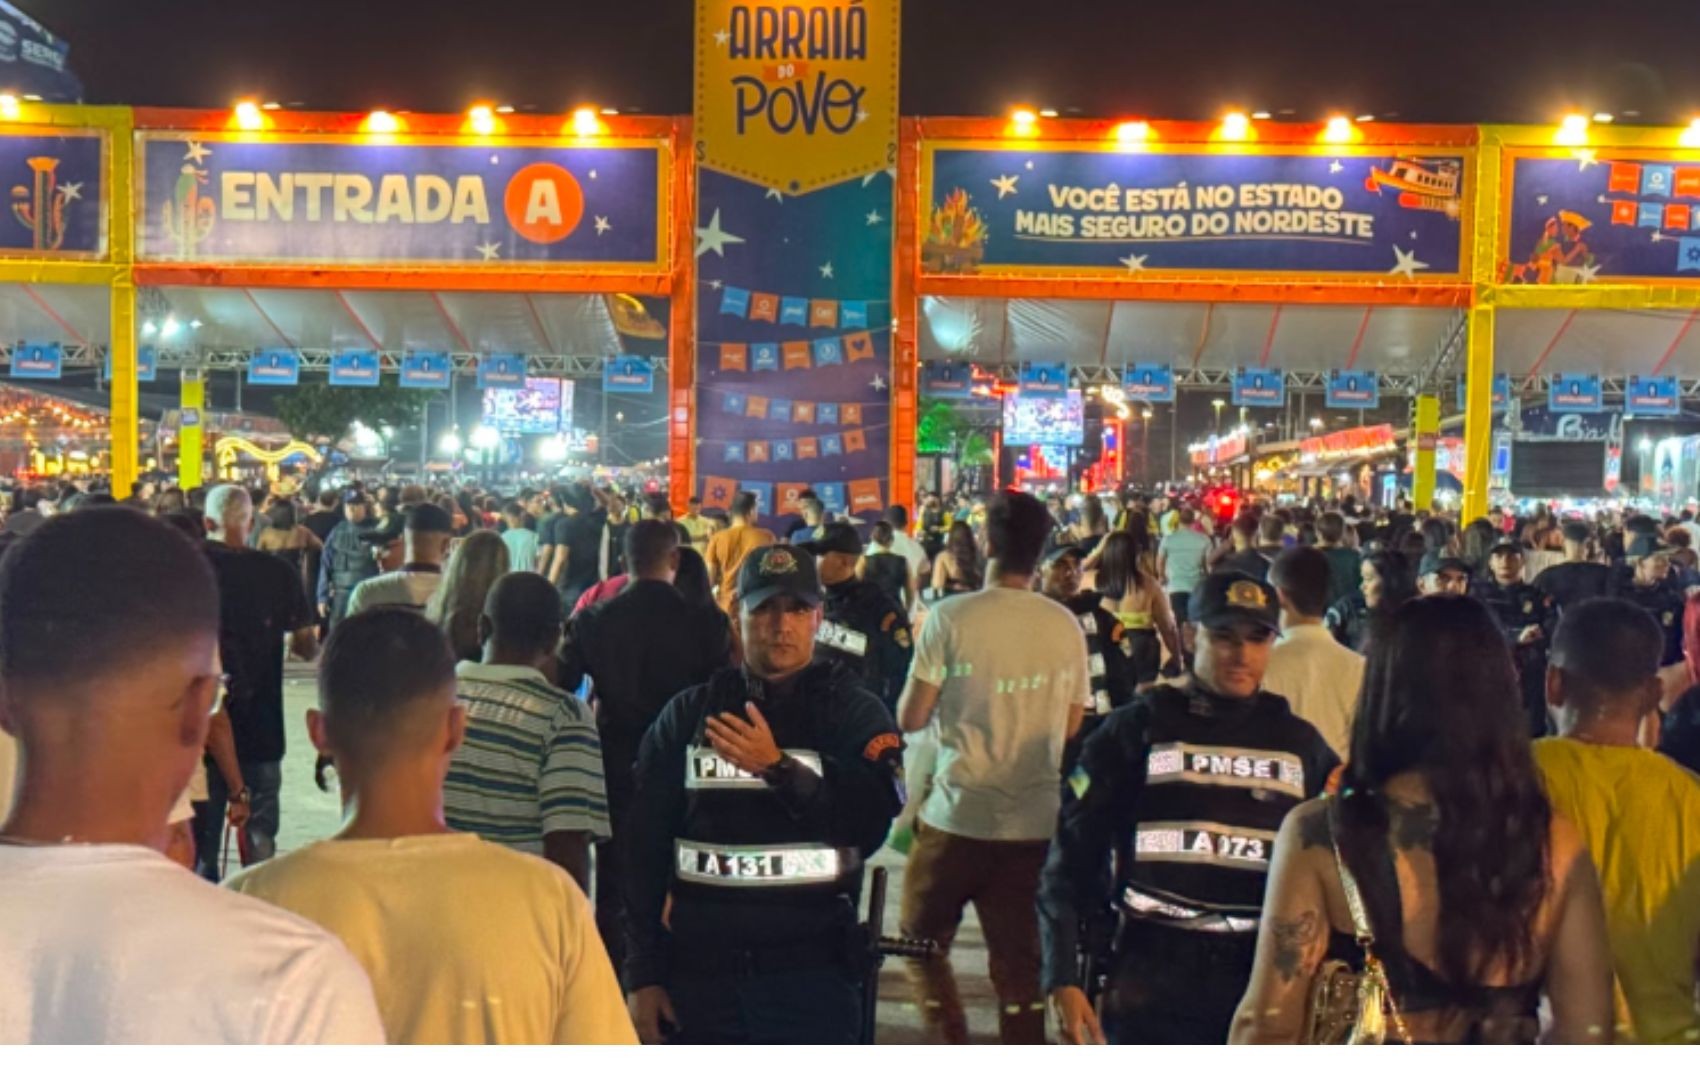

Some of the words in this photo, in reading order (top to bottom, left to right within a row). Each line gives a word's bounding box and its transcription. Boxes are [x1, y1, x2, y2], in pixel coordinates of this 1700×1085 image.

[728, 0, 867, 60] ARRAIÁ
[220, 170, 489, 225] ENTRADA
[524, 178, 562, 226] A
[1047, 183, 1120, 212] VOCÊ
[1125, 181, 1191, 212] ESTÁ
[1196, 184, 1235, 210] NO
[1239, 183, 1343, 210] ESTADO
[1015, 209, 1074, 237] MAIS
[1080, 214, 1185, 240] SEGURO
[1191, 212, 1230, 237] DO
[1234, 209, 1374, 239] NORDESTE
[1191, 753, 1271, 779] PMSE
[1191, 831, 1213, 855] A
[704, 850, 721, 876] A
[725, 852, 773, 876] 131
